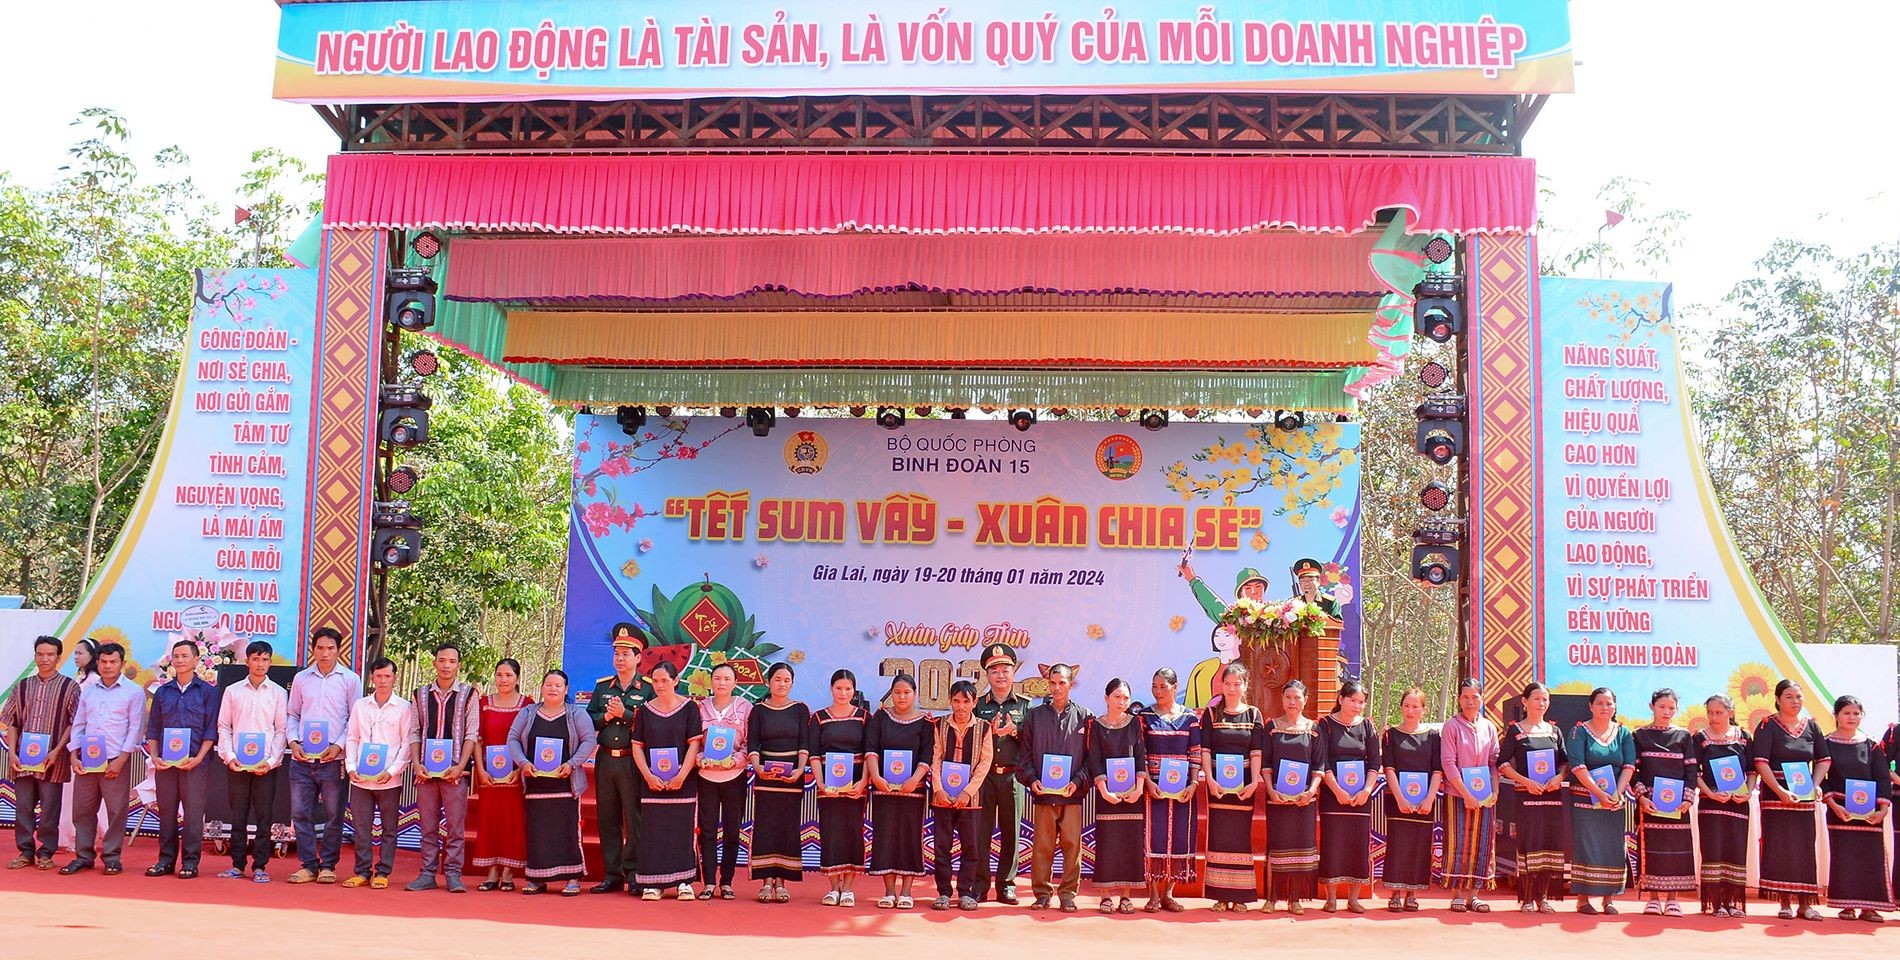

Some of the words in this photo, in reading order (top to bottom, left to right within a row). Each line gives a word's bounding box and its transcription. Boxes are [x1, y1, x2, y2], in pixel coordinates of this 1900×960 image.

[316, 22, 422, 73] NGƯỜI
[433, 31, 496, 70] LAO
[509, 20, 605, 78] ĐỘNG
[618, 18, 662, 67] LÀ
[674, 16, 729, 65] TÀI
[742, 10, 829, 68] SẢN,
[841, 14, 884, 62] LÀ
[898, 7, 972, 62] VỐN
[985, 12, 1057, 67] QUÝ
[1077, 7, 1146, 62] CỦA
[1159, 4, 1232, 63] MỖI
[1245, 24, 1373, 65] DOANH
[1386, 17, 1526, 76] NGHIỆP
[200, 328, 241, 349] CÔNG
[245, 328, 287, 349] ĐOÀN
[198, 361, 223, 380] NƠI
[228, 356, 246, 380] SẺ
[251, 362, 291, 383] CHIA,
[1564, 343, 1610, 366] NĂNG
[1615, 343, 1658, 370] SUẤT,
[195, 392, 221, 411] NƠI
[226, 387, 250, 411] GỬI
[255, 387, 290, 411] GẮM
[1564, 373, 1606, 398] CHẤT
[1611, 379, 1668, 403] LƯỢNG,
[233, 421, 265, 442] TÂM
[270, 423, 290, 443] TƯ
[1564, 408, 1601, 434] HIỆU
[1606, 407, 1640, 432] QUẢ
[887, 435, 912, 454] BỘ
[916, 433, 967, 453] QUỐC
[973, 436, 1036, 453] PHÒNG
[1564, 444, 1597, 463] CAO
[1602, 444, 1636, 464] HƠN
[209, 452, 243, 474] TÌNH
[247, 450, 286, 477] CẢM,
[891, 457, 939, 472] BINH
[945, 455, 1001, 473] ĐOÀN
[1009, 459, 1030, 474] 15
[175, 483, 235, 508] NGUYỆN
[240, 487, 284, 509] VỌNG,
[1564, 473, 1580, 496] VÌ
[1586, 473, 1639, 498] QUYỀN
[1644, 477, 1669, 502] LỢI
[202, 514, 220, 536] LÀ
[225, 515, 253, 536] MÁI
[258, 513, 283, 537] ẤM
[757, 499, 846, 543] SUM
[856, 491, 938, 544] VẦY
[974, 495, 1089, 547] XUÂN
[1098, 504, 1186, 550] CHIA
[1565, 504, 1599, 529] CỦA
[1604, 508, 1655, 531] NGƯỜI
[216, 544, 246, 568] CỦA
[251, 544, 281, 569] MỖI
[1566, 544, 1597, 563] LAO
[1601, 541, 1651, 567] ĐỘNG,
[813, 565, 838, 581] Gia
[842, 565, 868, 583] Lai,
[872, 567, 909, 584] ngày
[913, 567, 956, 583] 19-20
[960, 568, 1003, 586] tháng
[1006, 569, 1025, 584] 01
[1029, 569, 1063, 585] năm
[1067, 570, 1104, 586] 2024
[1567, 573, 1583, 596] VÌ
[1587, 576, 1611, 600] SỰ
[1615, 575, 1657, 597] PHÁT
[1661, 572, 1708, 598] TRIỂN
[174, 577, 215, 599] ĐOÀN
[220, 578, 254, 600] VIÊN
[259, 579, 278, 601] VÀ
[234, 610, 277, 635] ĐỘNG
[1567, 605, 1601, 630] BỀN
[1606, 607, 1650, 631] VỮNG
[885, 621, 937, 647] Xuân
[939, 622, 981, 653] Giáp
[983, 621, 1031, 648] Thìn
[1568, 638, 1602, 664] CỦA
[1607, 645, 1647, 665] BINH
[1651, 642, 1696, 665] ĐOÀN
[733, 662, 757, 681] 2024
